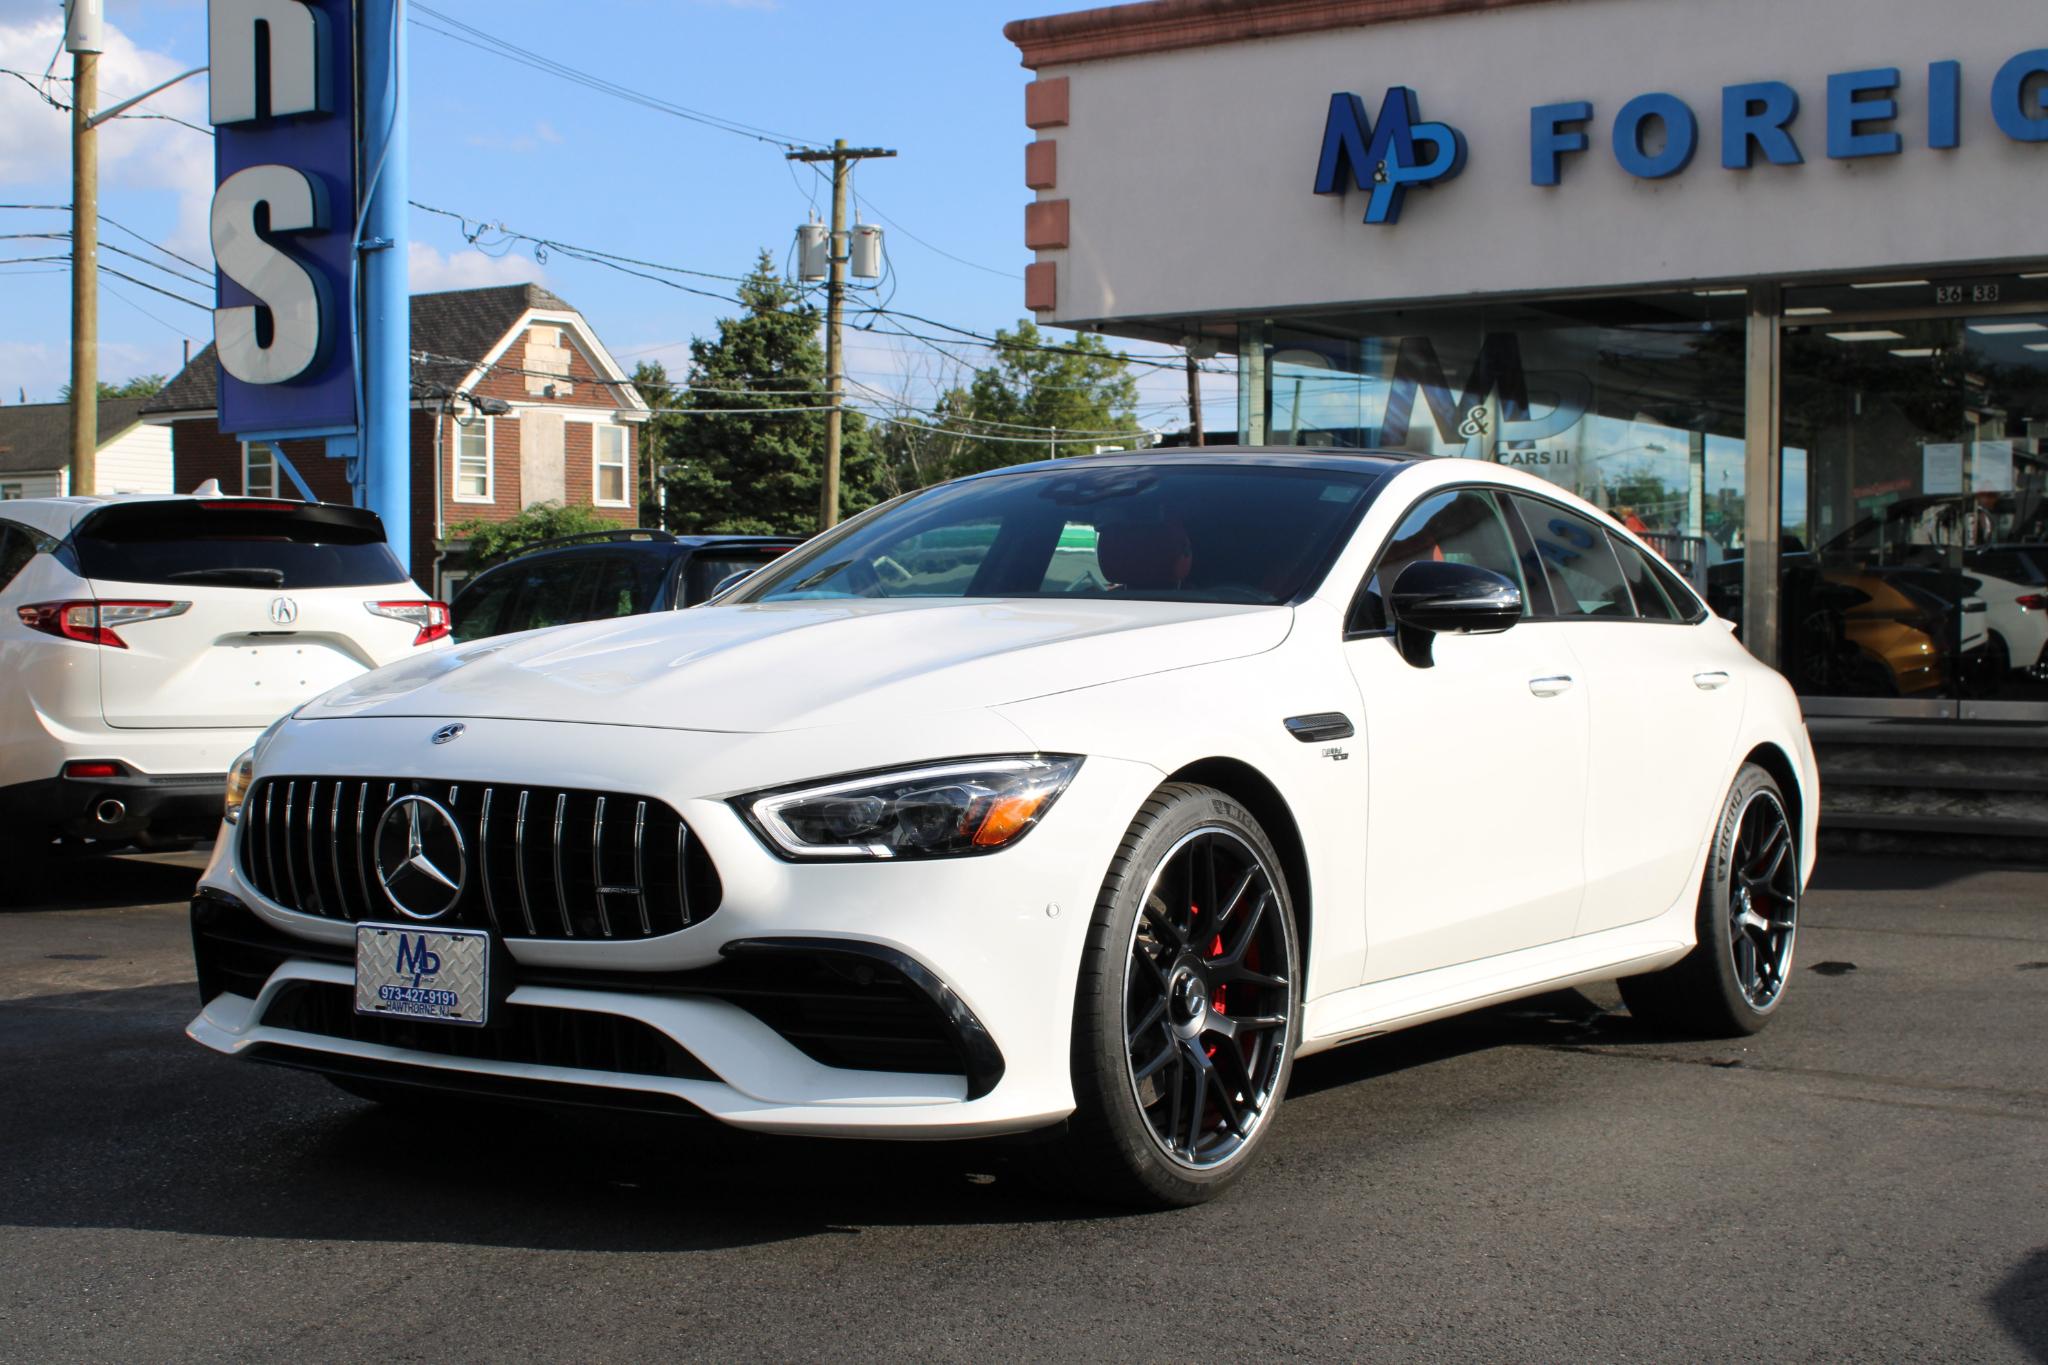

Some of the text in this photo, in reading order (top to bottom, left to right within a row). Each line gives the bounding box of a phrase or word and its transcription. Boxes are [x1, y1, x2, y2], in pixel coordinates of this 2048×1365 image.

[1938, 285, 1997, 302] 36 38
[1496, 451, 1551, 466] CARS
[381, 986, 456, 1005] 973-427-9191
